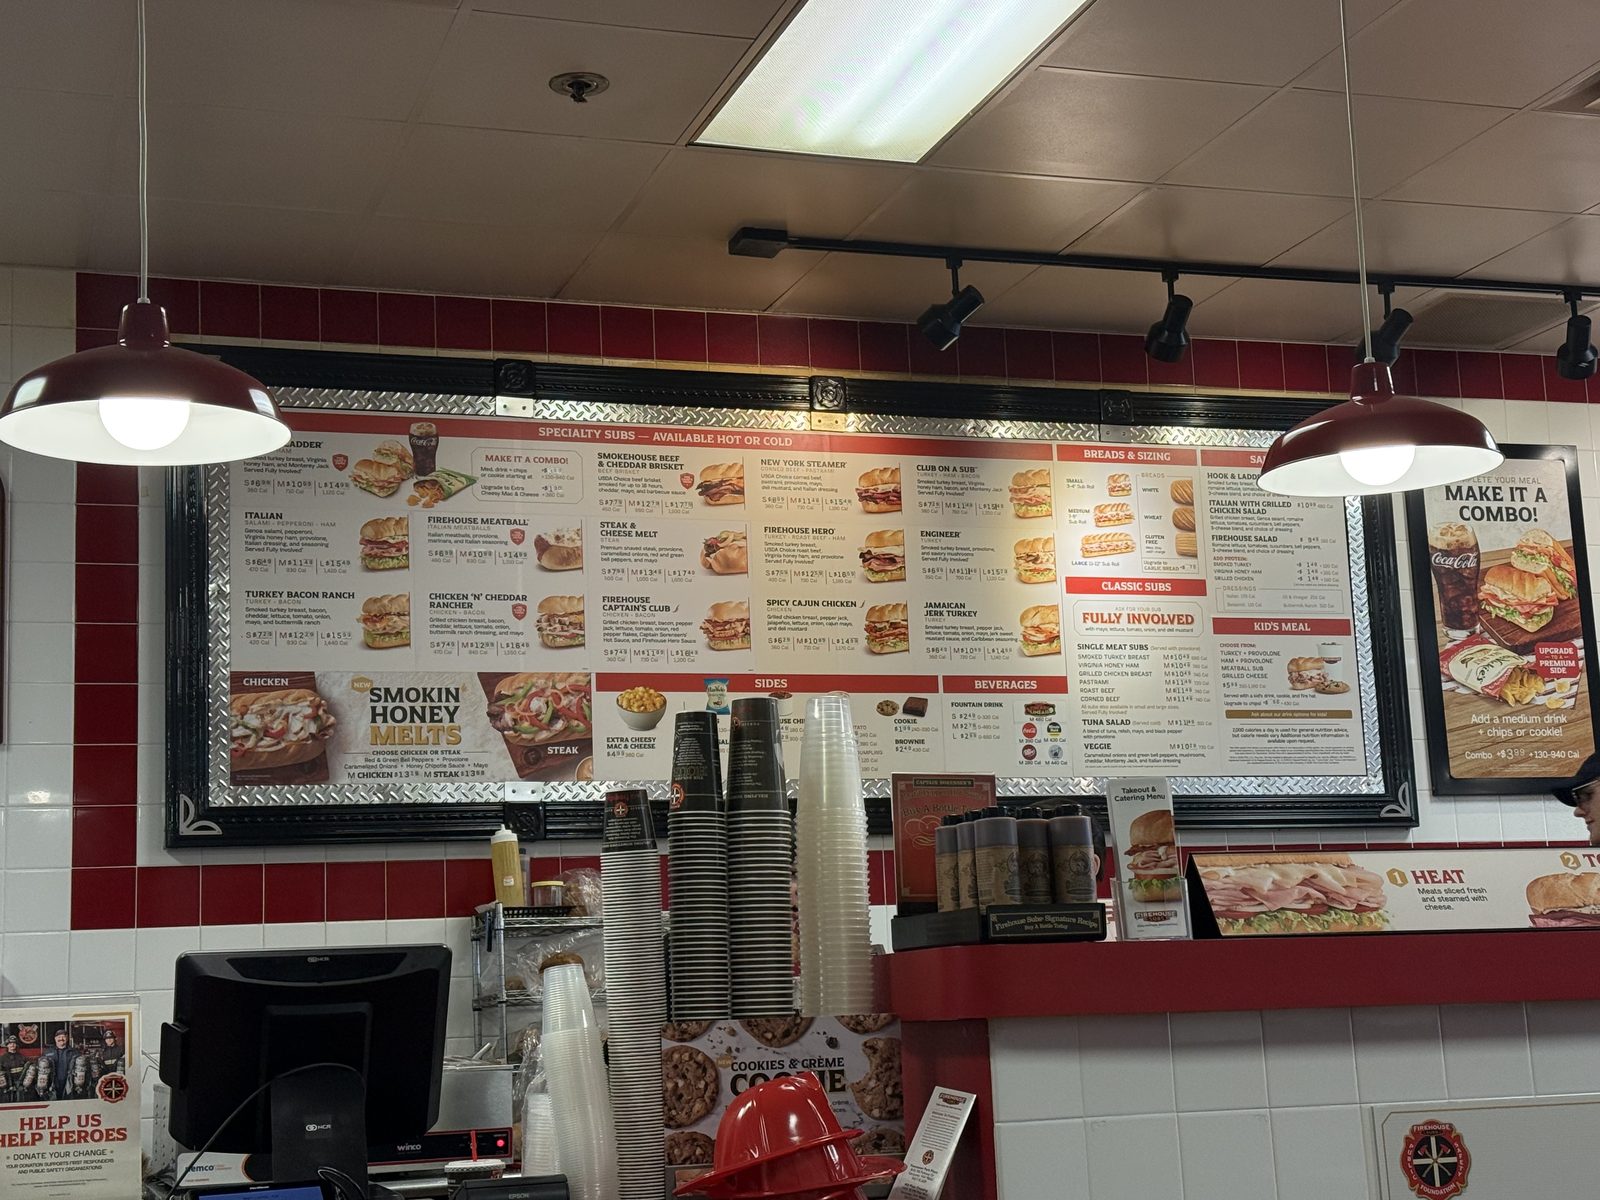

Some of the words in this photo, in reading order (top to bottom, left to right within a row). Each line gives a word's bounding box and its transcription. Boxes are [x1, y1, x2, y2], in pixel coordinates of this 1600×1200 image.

[538, 427, 601, 439] SPECIALTY
[604, 430, 635, 440] SUBS
[653, 432, 714, 444] AVAILABLE
[717, 435, 741, 444] HOT
[744, 436, 761, 447] OR
[764, 437, 792, 446] COLD
[598, 453, 657, 461] SMOKEHOUSE
[1084, 450, 1125, 460] BREADS
[1128, 451, 1135, 459] &
[1138, 451, 1171, 461] SIZING
[607, 461, 646, 469] CHEDDAR
[1446, 486, 1504, 502] MAKE
[1510, 486, 1527, 502] IT
[1535, 487, 1548, 503] A
[245, 512, 283, 520] ITALIAN
[1460, 506, 1538, 523] COMBO!
[428, 516, 479, 525] FIREHOUSE
[481, 518, 528, 526] MEATBALL
[1432, 552, 1478, 568] Coca-Cola
[1102, 582, 1143, 591] CLASSIC
[1145, 583, 1172, 591] SUBS
[245, 590, 284, 599] TURKEY
[287, 591, 319, 599] BACON
[429, 593, 469, 601] CHICKEN
[1082, 612, 1123, 624] FULLY
[1128, 613, 1194, 625] INVOLVED
[1254, 621, 1279, 631] KID'S
[1282, 623, 1311, 631] MEAL
[1539, 647, 1574, 655] UPGRADE
[1539, 660, 1576, 668] PREMIUM
[243, 678, 289, 686] CHICKEN
[754, 678, 788, 689] SIDES
[975, 680, 1037, 689] BEVERAGES
[369, 687, 461, 704] SMOKIN
[370, 705, 460, 724] HONEY
[1471, 714, 1490, 724] Add
[1493, 716, 1499, 724] a
[1503, 714, 1541, 724] medium
[1544, 714, 1567, 724] drink
[370, 724, 462, 746] MELTS
[1487, 727, 1513, 738] chips
[1516, 729, 1526, 737] or
[1529, 727, 1563, 737] cookie!
[1465, 752, 1492, 760] Combo
[1115, 794, 1145, 803] Catering
[1411, 870, 1465, 884] HEAT
[1135, 911, 1177, 920] FIREHOUSE
[731, 1059, 785, 1071] COOKIES
[789, 1058, 800, 1069] &
[802, 1056, 844, 1068] CRÈME
[20, 1115, 70, 1131] HELP
[77, 1114, 102, 1128] US
[49, 1128, 127, 1145] HEROES
[397, 1143, 422, 1152] winco
[13, 1152, 46, 1161] DONATE
[49, 1151, 71, 1159] YOUR
[73, 1149, 107, 1158] CHANGE
[1455, 1143, 1464, 1176] SAFETY
[1408, 1144, 1417, 1180] PUBLIC
[1420, 1183, 1457, 1195] FOUNDATION
